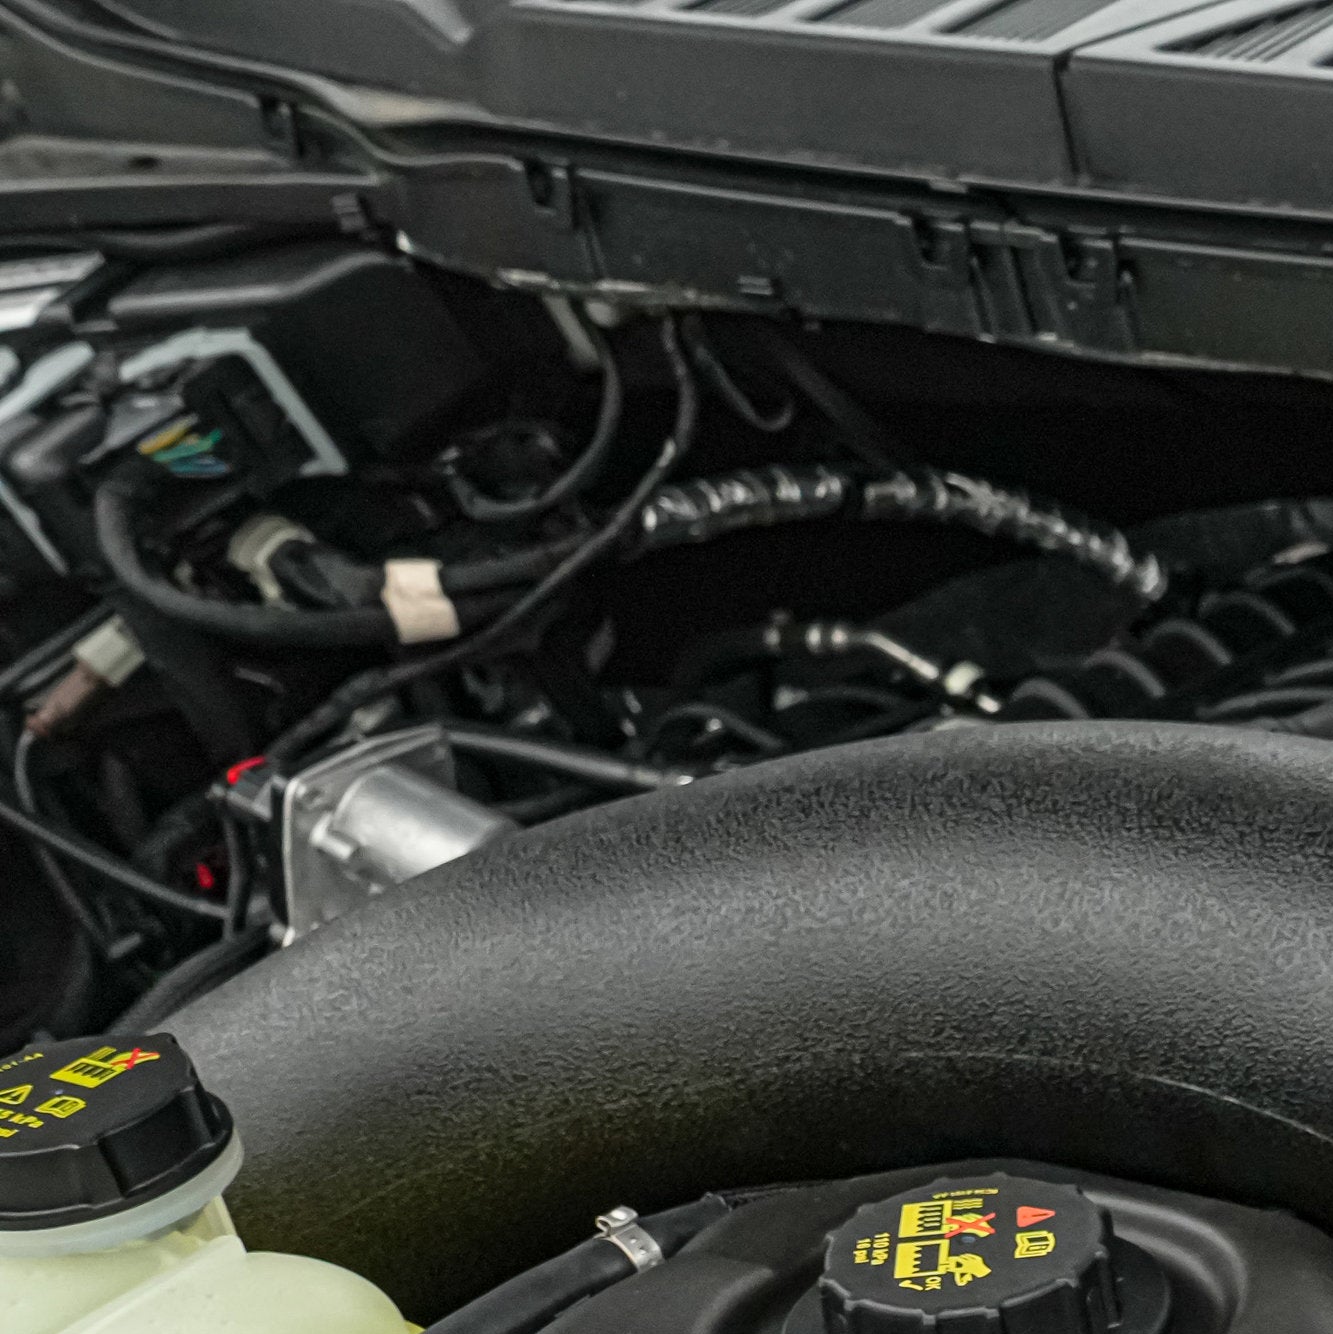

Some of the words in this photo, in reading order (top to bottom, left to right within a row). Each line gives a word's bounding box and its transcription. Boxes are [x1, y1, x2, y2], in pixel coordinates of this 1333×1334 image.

[873, 1232, 890, 1248] 110
[870, 1248, 889, 1266] kPa
[925, 1276, 942, 1291] OK
